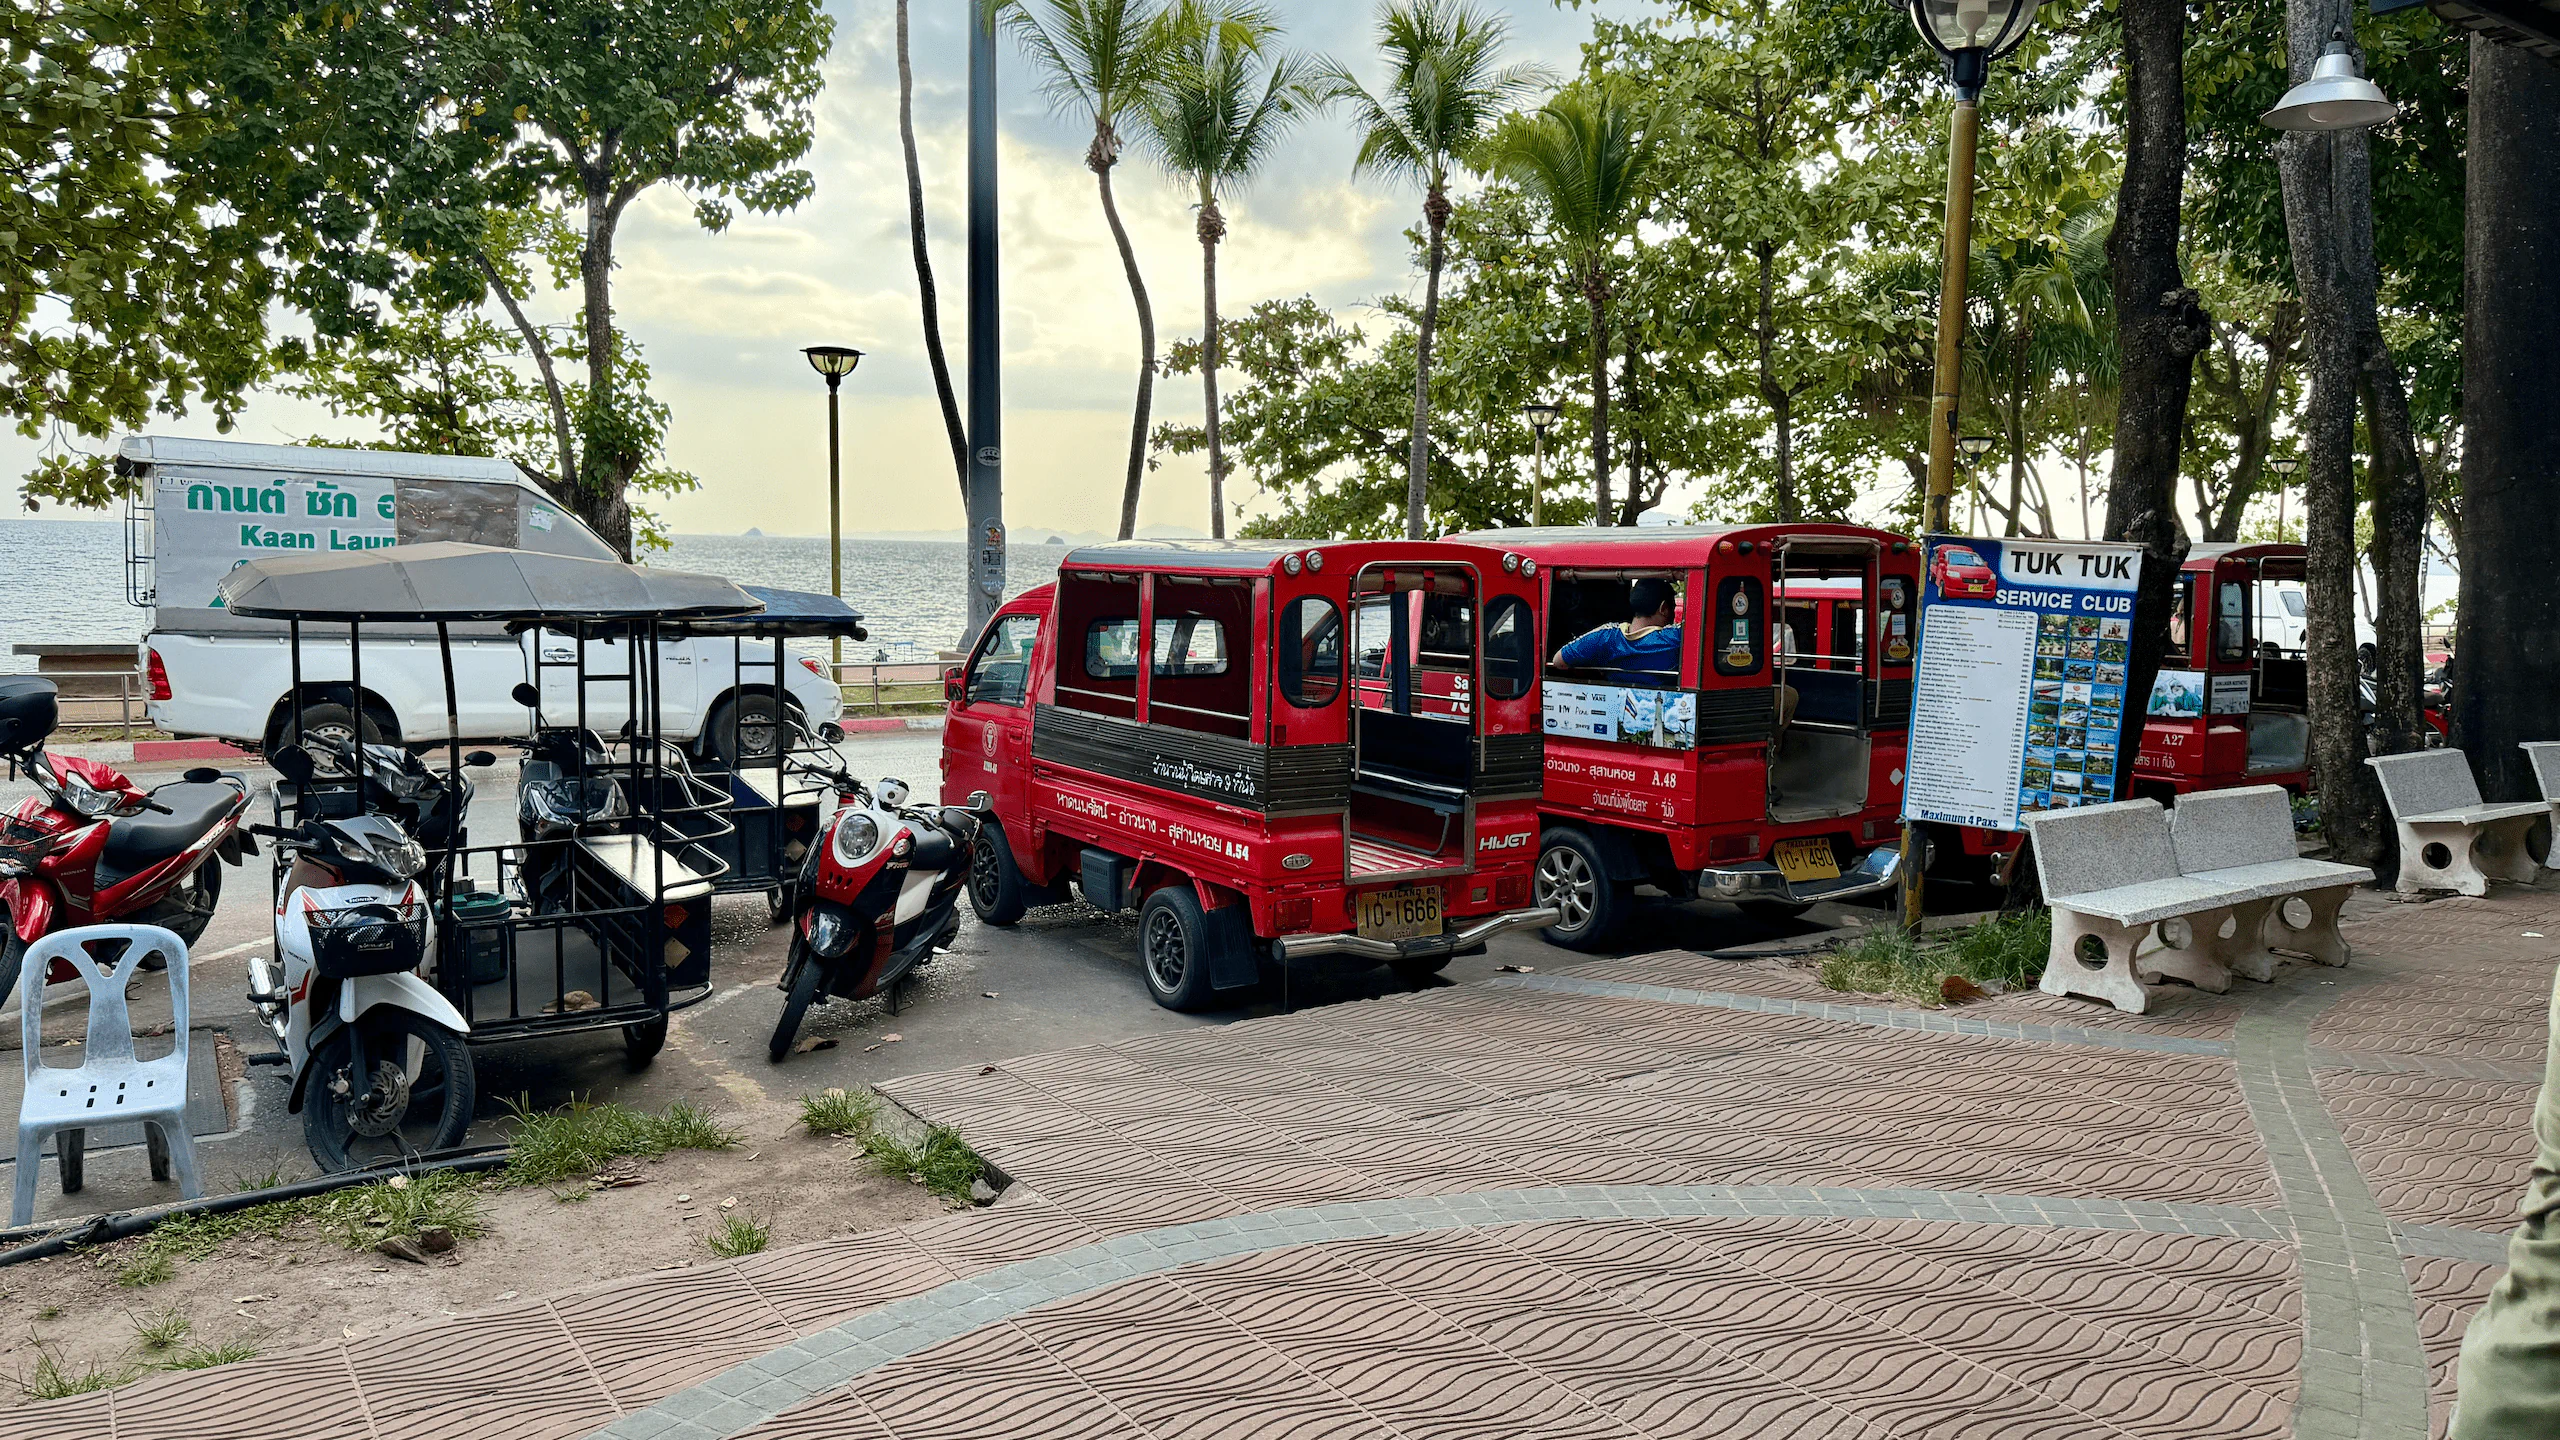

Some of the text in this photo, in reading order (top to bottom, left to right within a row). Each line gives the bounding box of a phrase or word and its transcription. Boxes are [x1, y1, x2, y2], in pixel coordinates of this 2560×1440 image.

[188, 479, 286, 513] กานต์
[241, 525, 315, 549] Kaan
[2010, 551, 2132, 580] TUK TUK
[1995, 589, 2131, 613] SERVICE CLUB
[1592, 694, 1606, 702] VANS
[2162, 734, 2184, 746] A27
[1547, 757, 1580, 774] อ่าวนาง
[1589, 765, 1636, 782] สุสานหอย
[1652, 770, 1677, 789] A.48
[2152, 757, 2160, 767] 11
[1921, 810, 1998, 828] Maximum 4 Paxs
[1119, 807, 1157, 834] อ่าวนาง
[1168, 823, 1222, 852] สุสานหอย
[1225, 841, 1250, 861] A.54
[1479, 832, 1531, 851] HIJET
[1778, 847, 1834, 870] 10-1490
[1376, 888, 1422, 900] THAILAND
[1365, 897, 1437, 928] 10-1666
